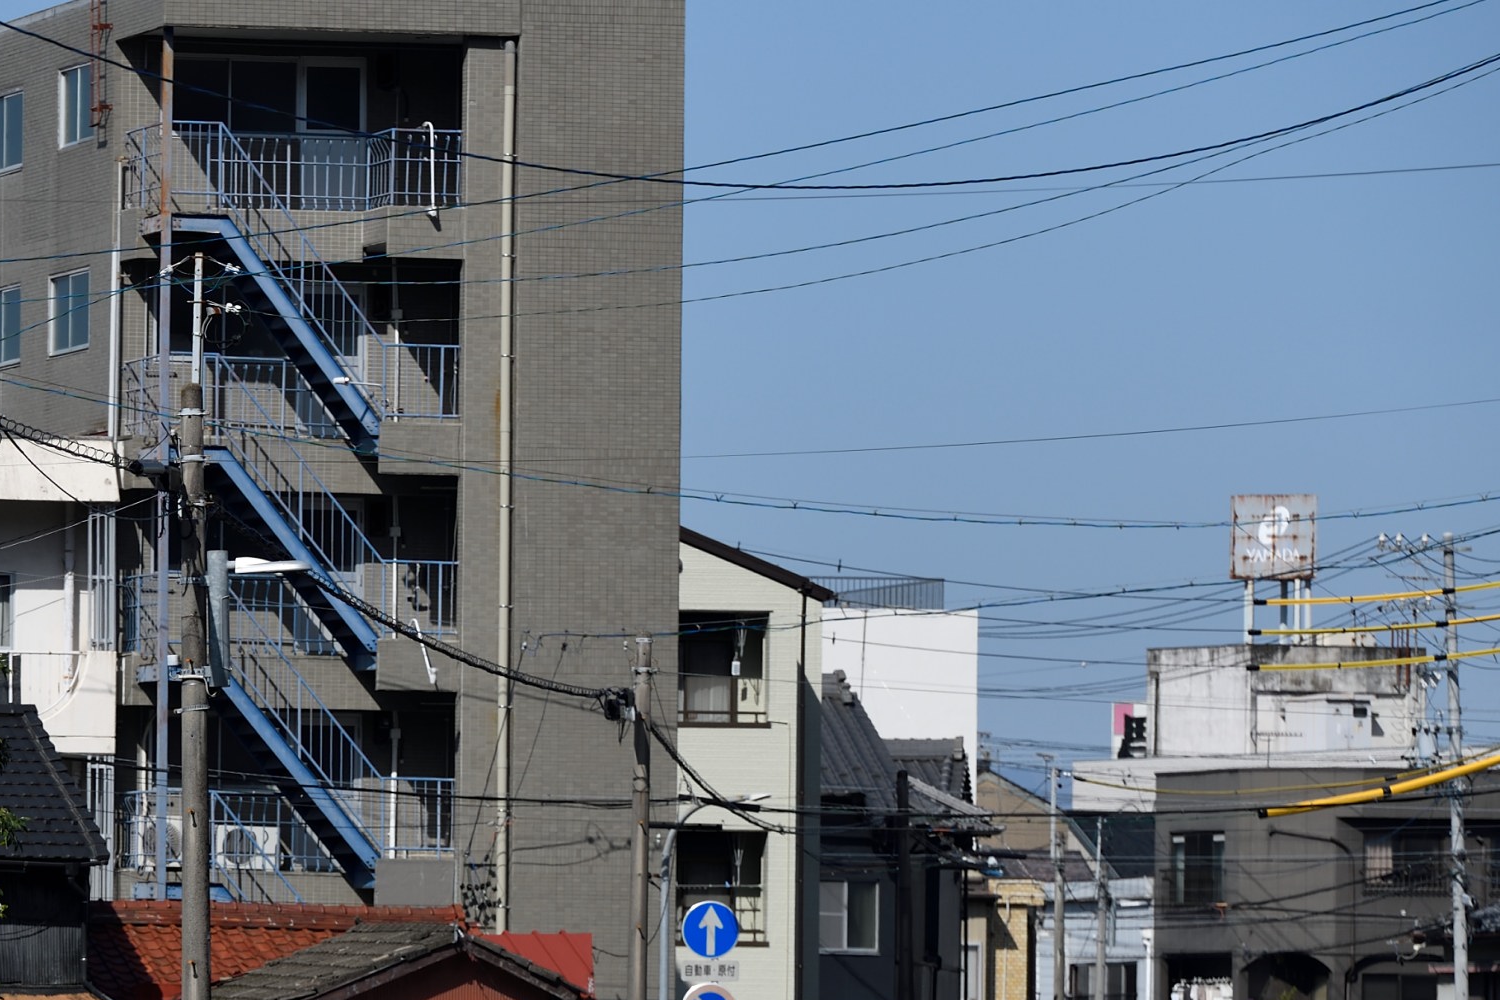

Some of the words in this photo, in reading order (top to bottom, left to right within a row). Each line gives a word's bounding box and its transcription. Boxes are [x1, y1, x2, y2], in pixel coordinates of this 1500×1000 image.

[1246, 547, 1300, 563] YAMADA
[684, 964, 736, 977] 自動車・原付
